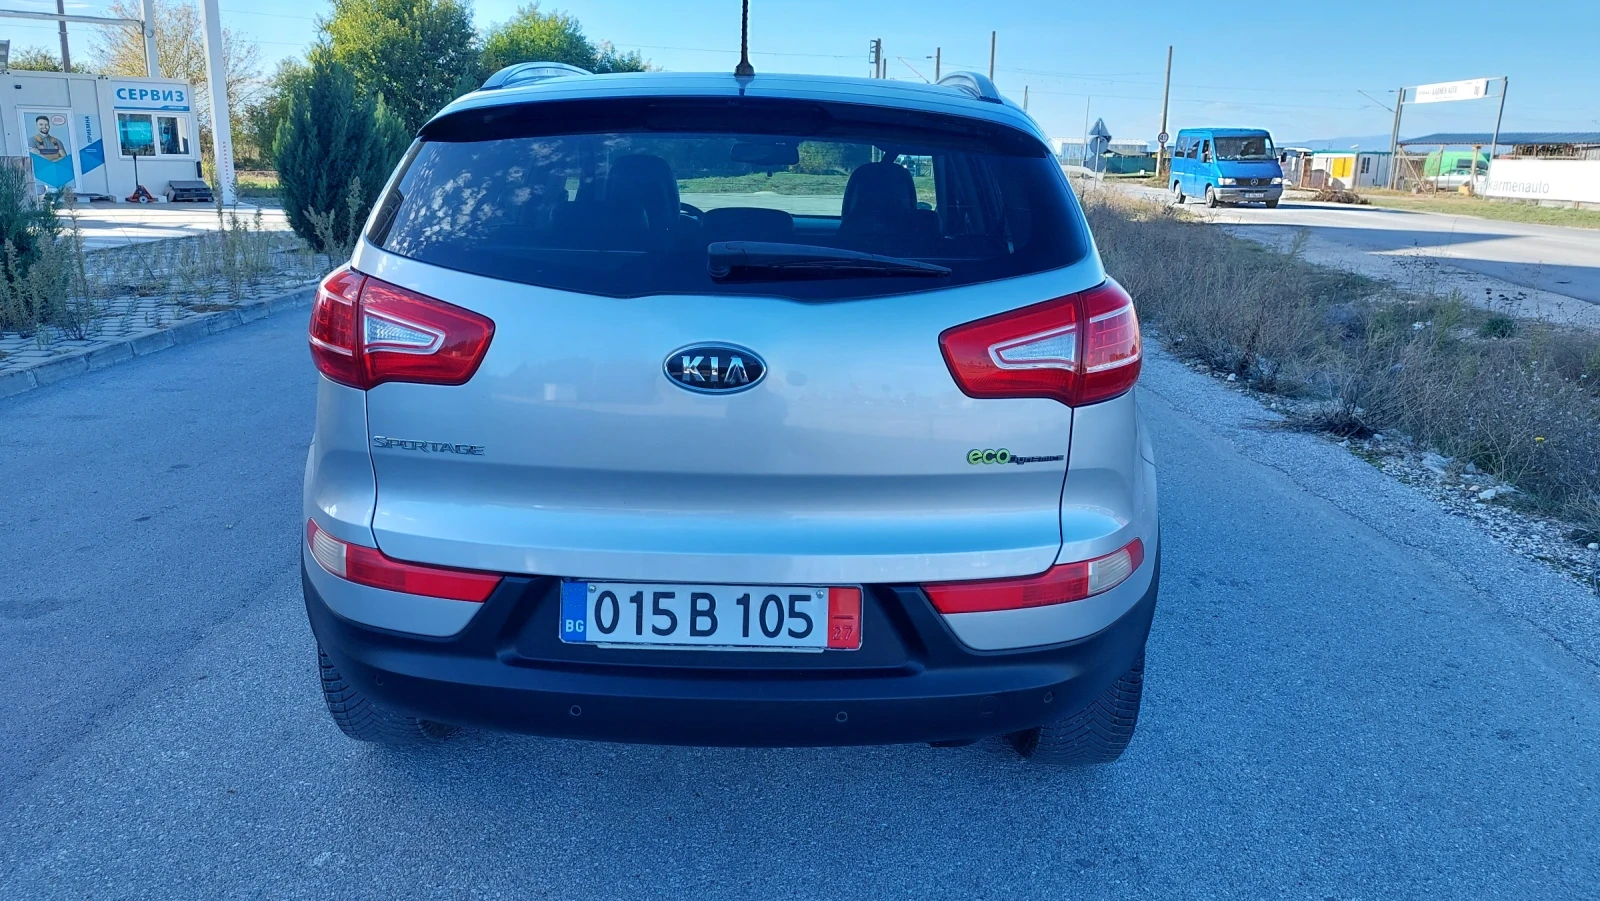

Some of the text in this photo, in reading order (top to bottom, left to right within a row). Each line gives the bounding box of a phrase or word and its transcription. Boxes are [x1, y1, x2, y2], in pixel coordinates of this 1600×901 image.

[116, 87, 185, 102] СЕРВИЗ
[84, 115, 93, 143] ПРИЕМНА
[1487, 177, 1550, 194] karmenauto
[681, 355, 750, 382] KIA
[373, 435, 486, 456] SPORTAGE
[565, 620, 584, 633] BG
[832, 625, 854, 641] 27
